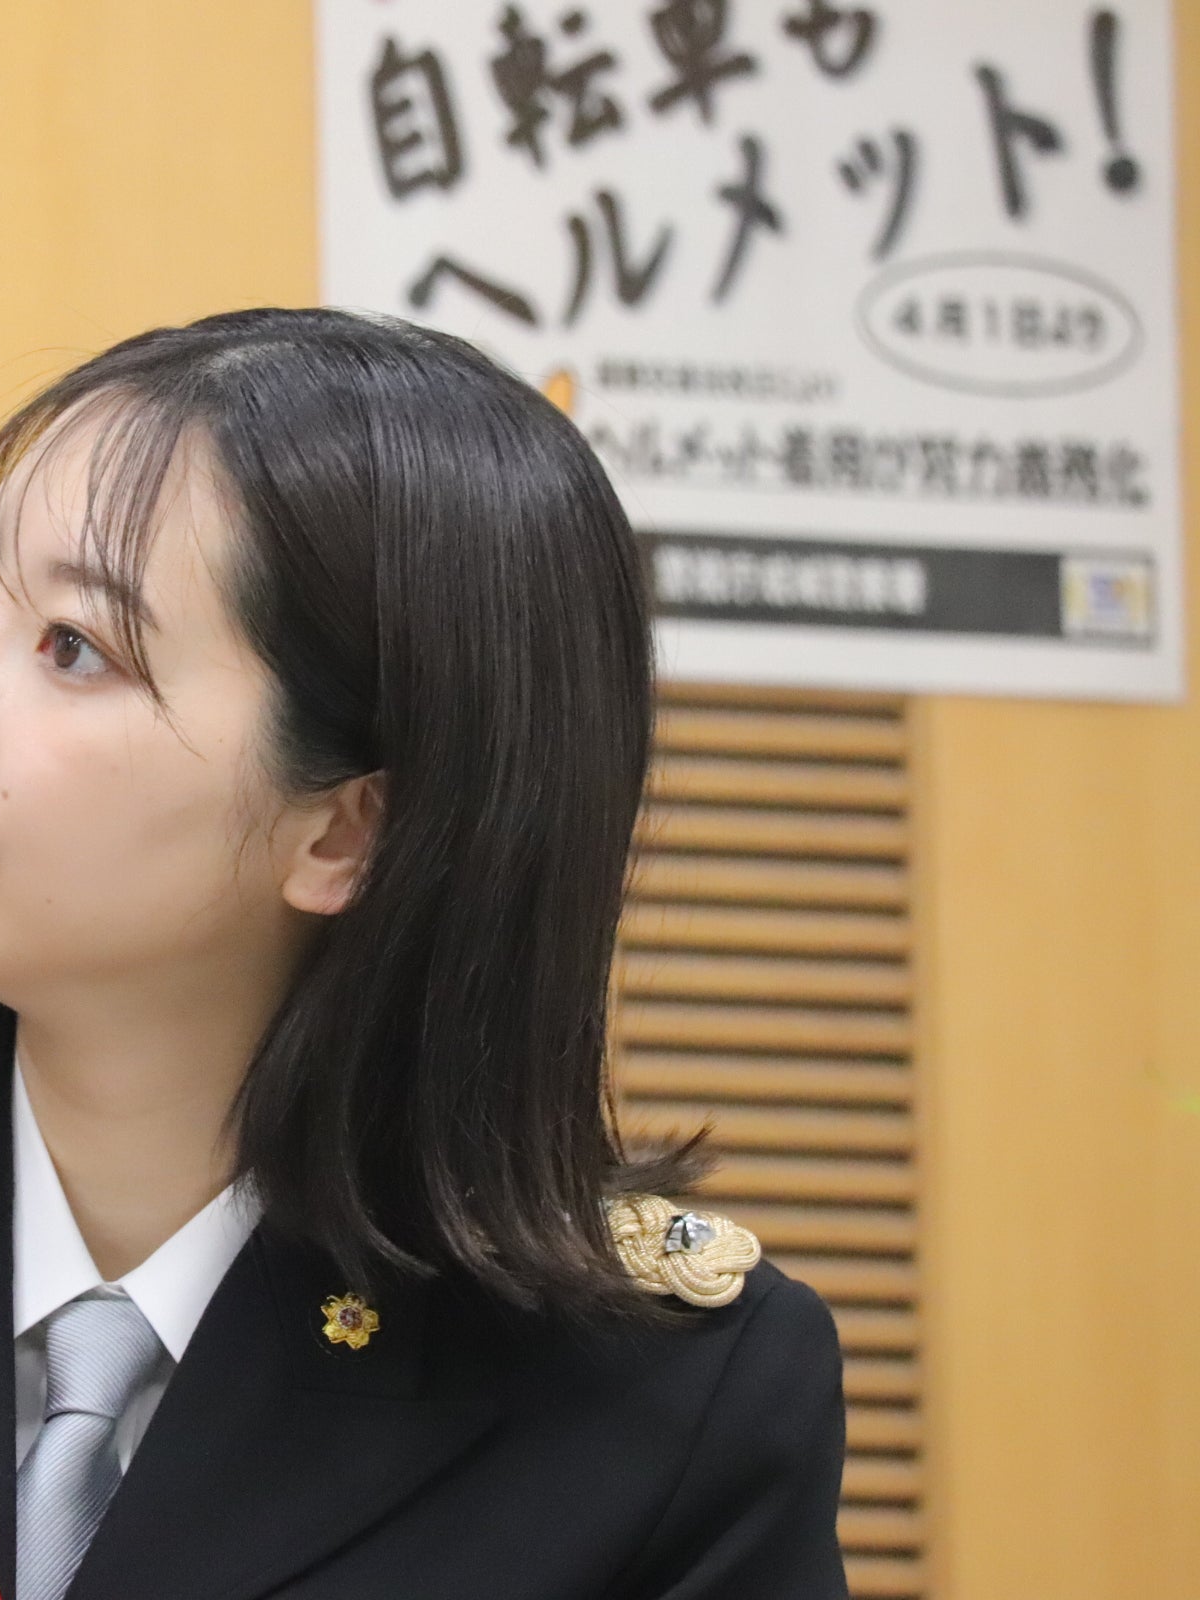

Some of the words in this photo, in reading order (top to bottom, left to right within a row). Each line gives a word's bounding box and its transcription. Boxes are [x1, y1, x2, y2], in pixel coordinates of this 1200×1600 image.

[406, 8, 1142, 328] ヘルメット!
